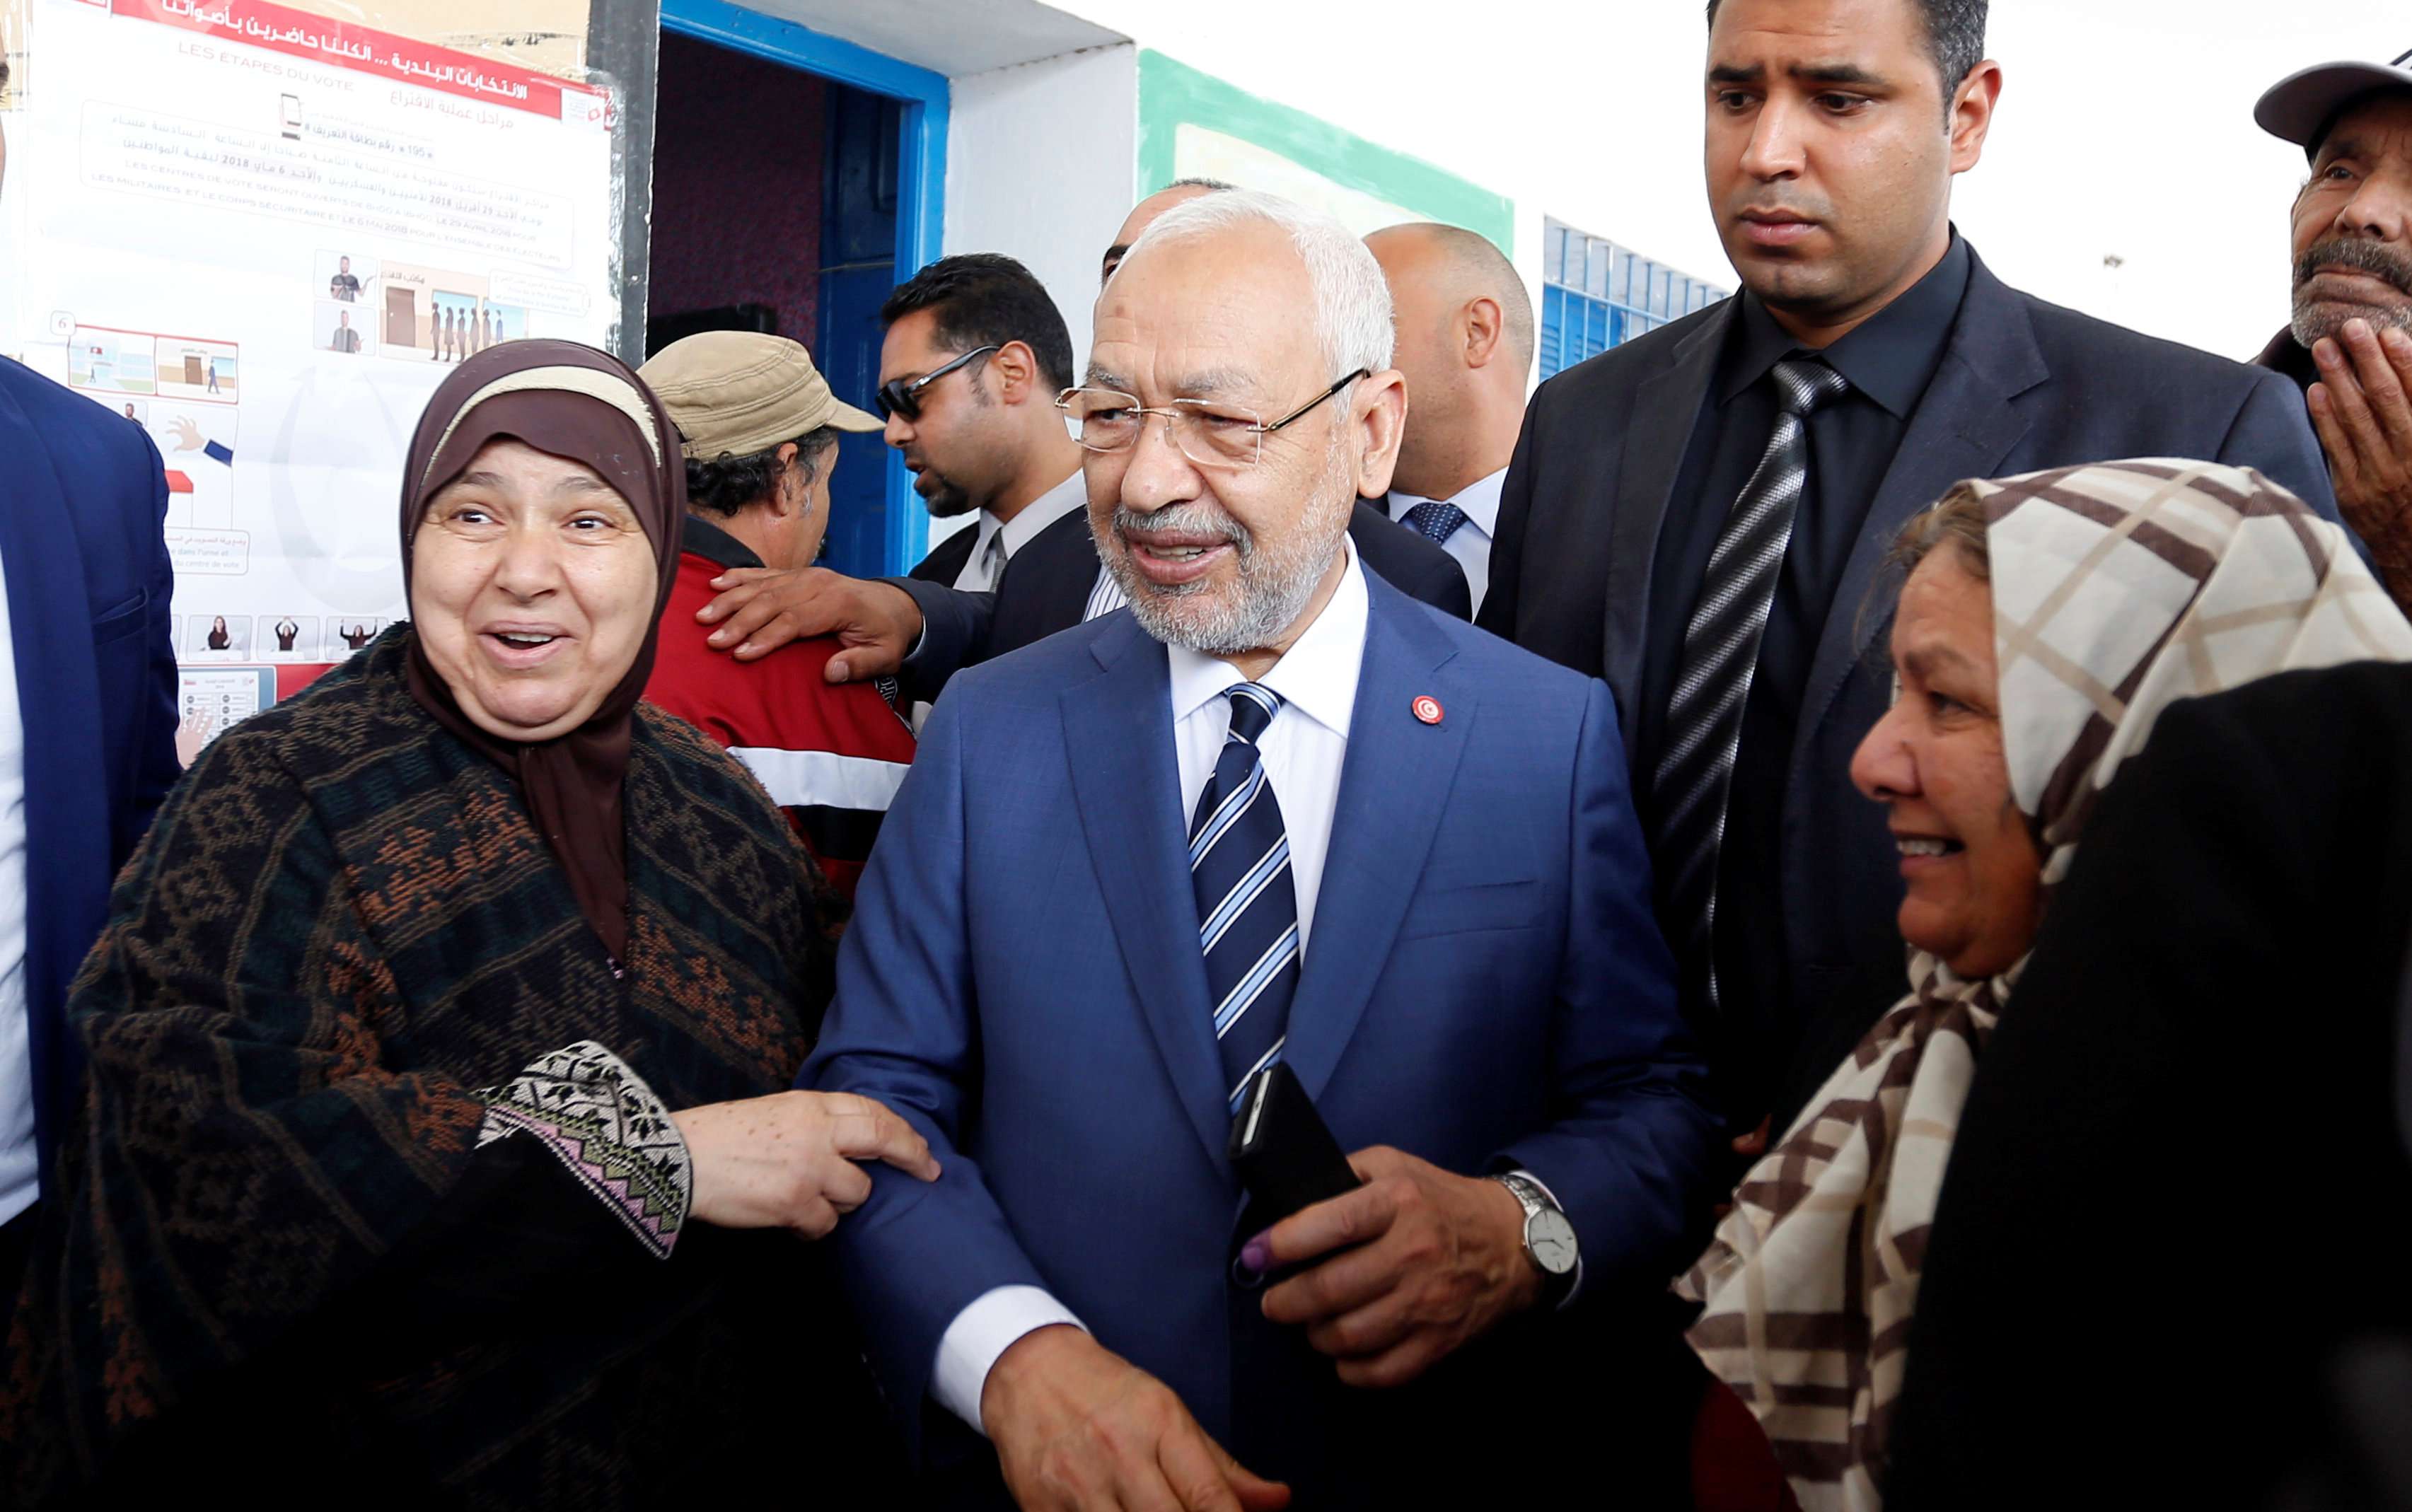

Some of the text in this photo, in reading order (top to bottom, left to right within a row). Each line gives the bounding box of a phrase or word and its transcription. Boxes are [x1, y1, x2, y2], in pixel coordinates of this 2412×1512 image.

[245, 16, 319, 49] حاضرين
[178, 40, 215, 62] LES
[286, 68, 309, 82] DU
[311, 74, 354, 92] VOTE
[390, 52, 454, 83] البلدية
[456, 68, 528, 100] الانتخابات
[390, 90, 514, 131] مراحل عملية الاقتراع
[221, 154, 249, 170] 2018
[279, 164, 286, 175] 6
[429, 194, 453, 208] 2018
[58, 318, 66, 329] 6
